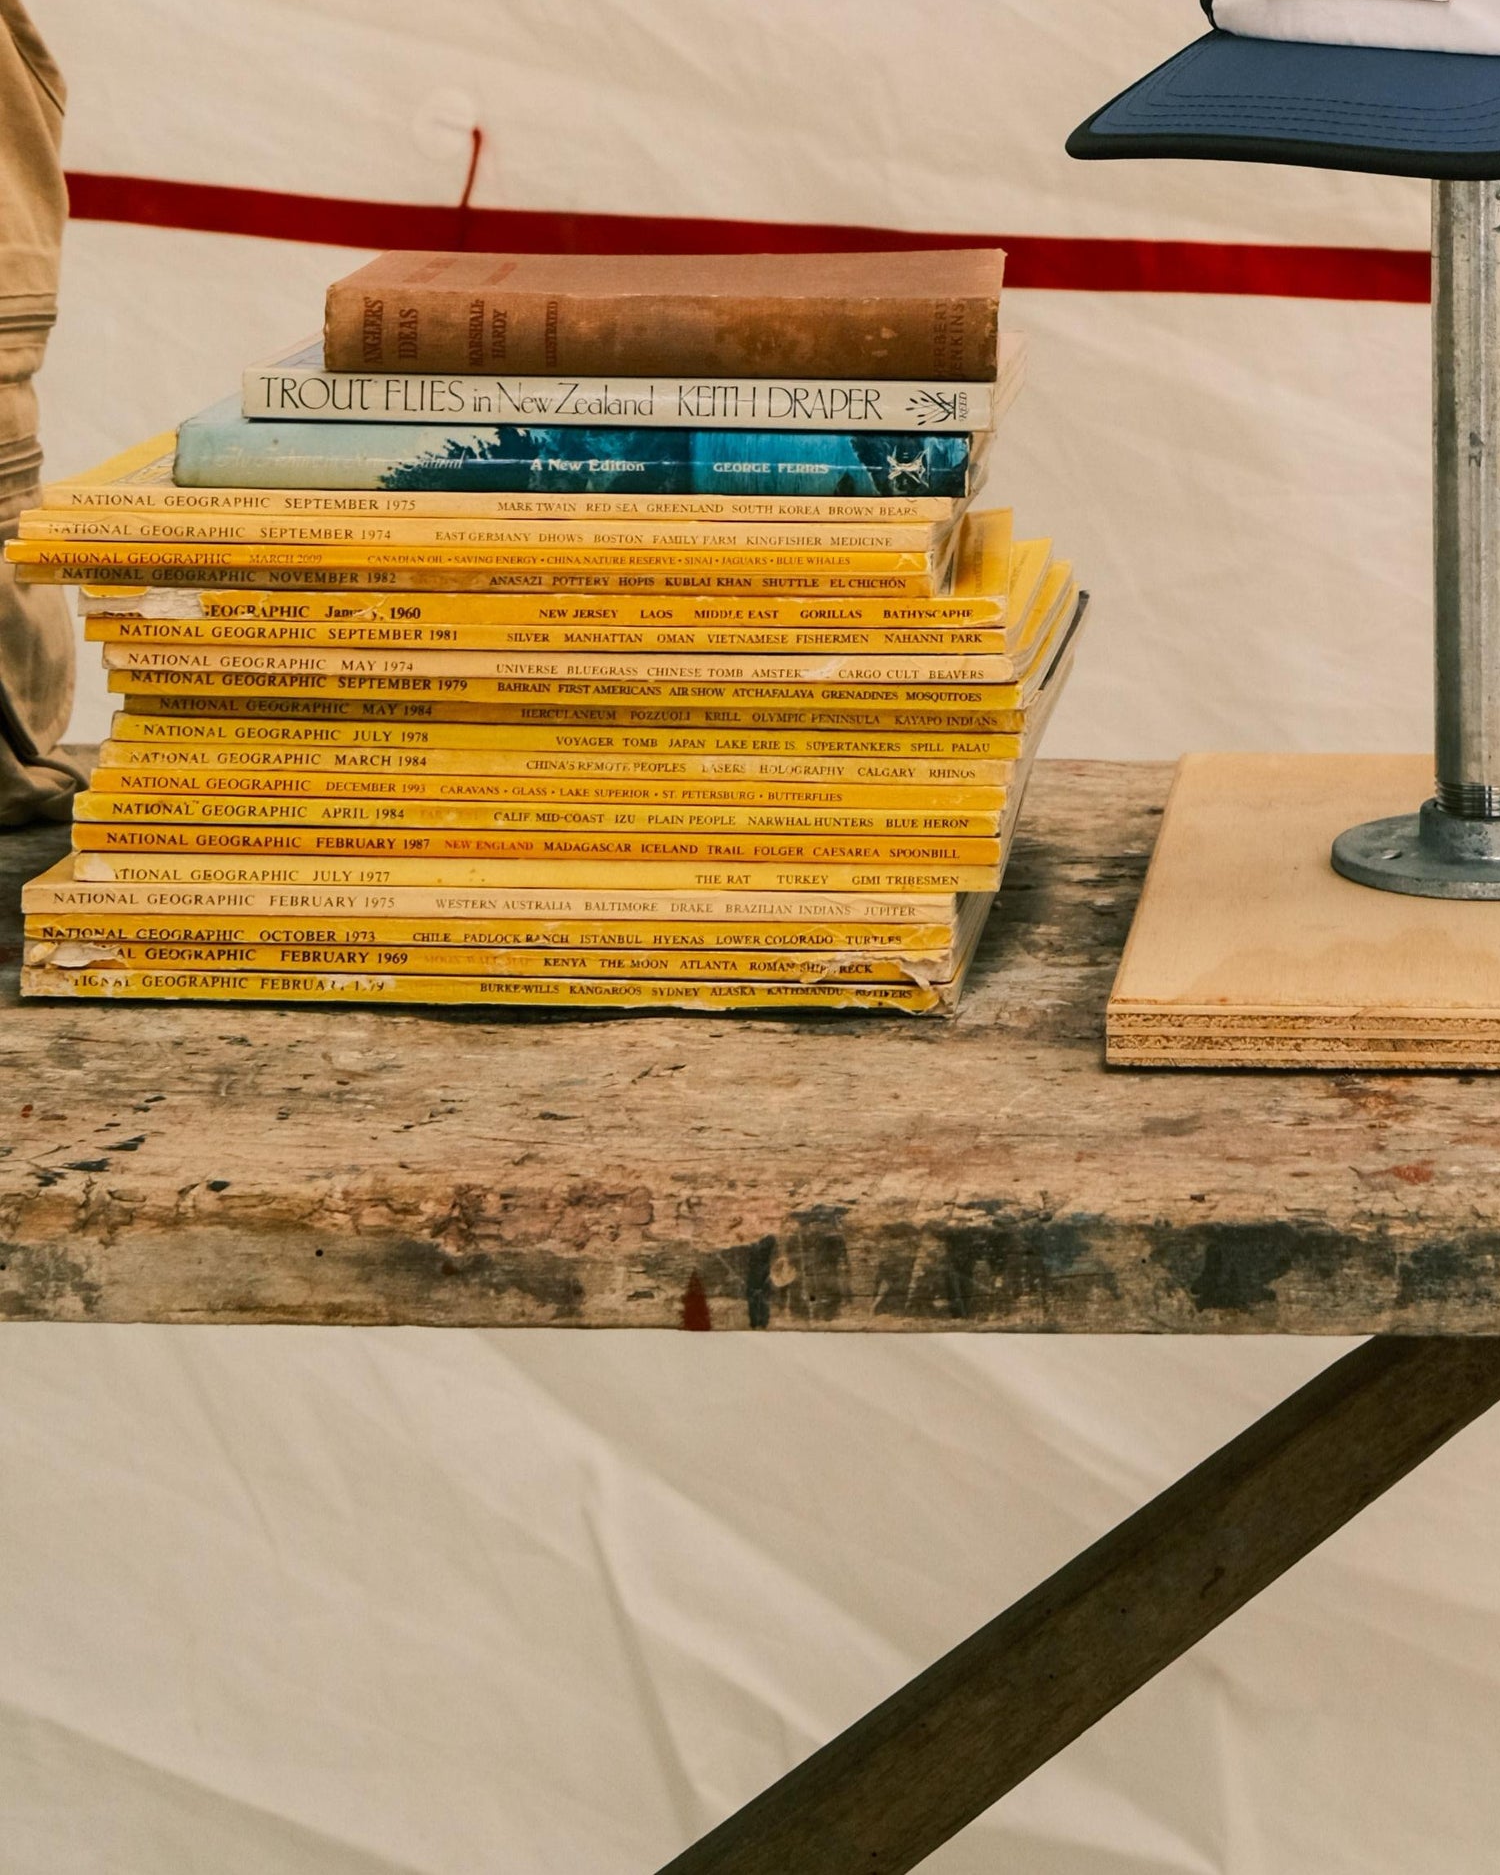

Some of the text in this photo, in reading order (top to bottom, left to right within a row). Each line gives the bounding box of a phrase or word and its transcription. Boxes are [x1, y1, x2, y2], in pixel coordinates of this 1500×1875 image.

[398, 307, 419, 360] IDEAS
[492, 308, 508, 359] HARDY
[260, 377, 882, 421] TROUT FLIES in New Zealand KEITH DRAPER
[530, 458, 829, 473] A New Edition GEORGE FERRIS
[72, 493, 724, 514] NATIONAL GEOGRAPHIC SEPTEMBER 1975 RED GREENLAND
[140, 525, 892, 548] GEOGRAPHIC SEPTEMBER 1974 GERMANY DHOWS BOSTON FAMILY KINGFISHER MEDICINE
[39, 553, 850, 566] NATIONAL GEOGRAPHIC OIL ENERGY CHINA WHALES
[62, 568, 751, 587] NATIONAL GEOGRAPHIC NOVEMBER 1982 KUBLAI KHAN
[390, 608, 862, 619] 1960 NEW JERSEY LAOS EAST GORILLAS
[120, 624, 982, 643] NATIONAL GEOGRAPHIC SEPTEMBER 1981 FISHERMEN PARK
[128, 652, 920, 679] NATIONAL GEOGRAPHIC MAY 1974 TOMB CULT
[222, 674, 982, 703] GEOGRAPHIC SEPTEMBER 1979 BAHRAIN AMERICANS ATCHAFALAYA GRENADINES MOSQUITOES
[160, 696, 998, 726] NATIONAL GEOGRAPHIC MAY 1984 POZZUOLI KRILL OLYMPIC PENINSULA KAYAPO INDIANS
[144, 724, 780, 749] NATIONAL GEOGRAPHIC JULY 1978 VOYAGER ERIE
[217, 753, 976, 779] GEOGRAPHIC MARCH 1984 PEOPLES CALGARY RHINOS
[121, 776, 843, 802] NATIONAL GEOGRAPHIC DECEMBER LAKE SUPERIOR BUTTERFLIES
[113, 802, 969, 829] NATIONAL GEOGRAPHIC APRIL 1984 BLUE HERON
[107, 832, 960, 859] NATIONAL GEOGRAPHIC FEBRUARY 1987 MADAGASCAR CAESAREA SPOONBILL
[190, 870, 959, 885] GEOGRAPHIC JULY RAT TURKEY GIMI TRIBESMEN
[53, 892, 658, 912] NATIONAL GEOGRAPHIC FEBRUARY 1975 WESTERN BALTIMORE
[259, 930, 833, 945] OCTOBER 1973 CHILE PADLOCK HYENAS COLORADO
[145, 947, 257, 962] GEOGRAPHIC
[281, 950, 369, 963] FEBRUARY
[378, 952, 408, 964] 1969
[544, 958, 587, 967] KENYA
[599, 959, 624, 968] THE
[680, 960, 738, 971] ATLANTA
[142, 976, 248, 989] GEOGRAPHIC
[480, 983, 560, 994] BURKE-WILLS
[569, 985, 642, 996] KANGAROOS
[651, 987, 700, 997] SYDNEY
[711, 987, 756, 995] ALASKA
